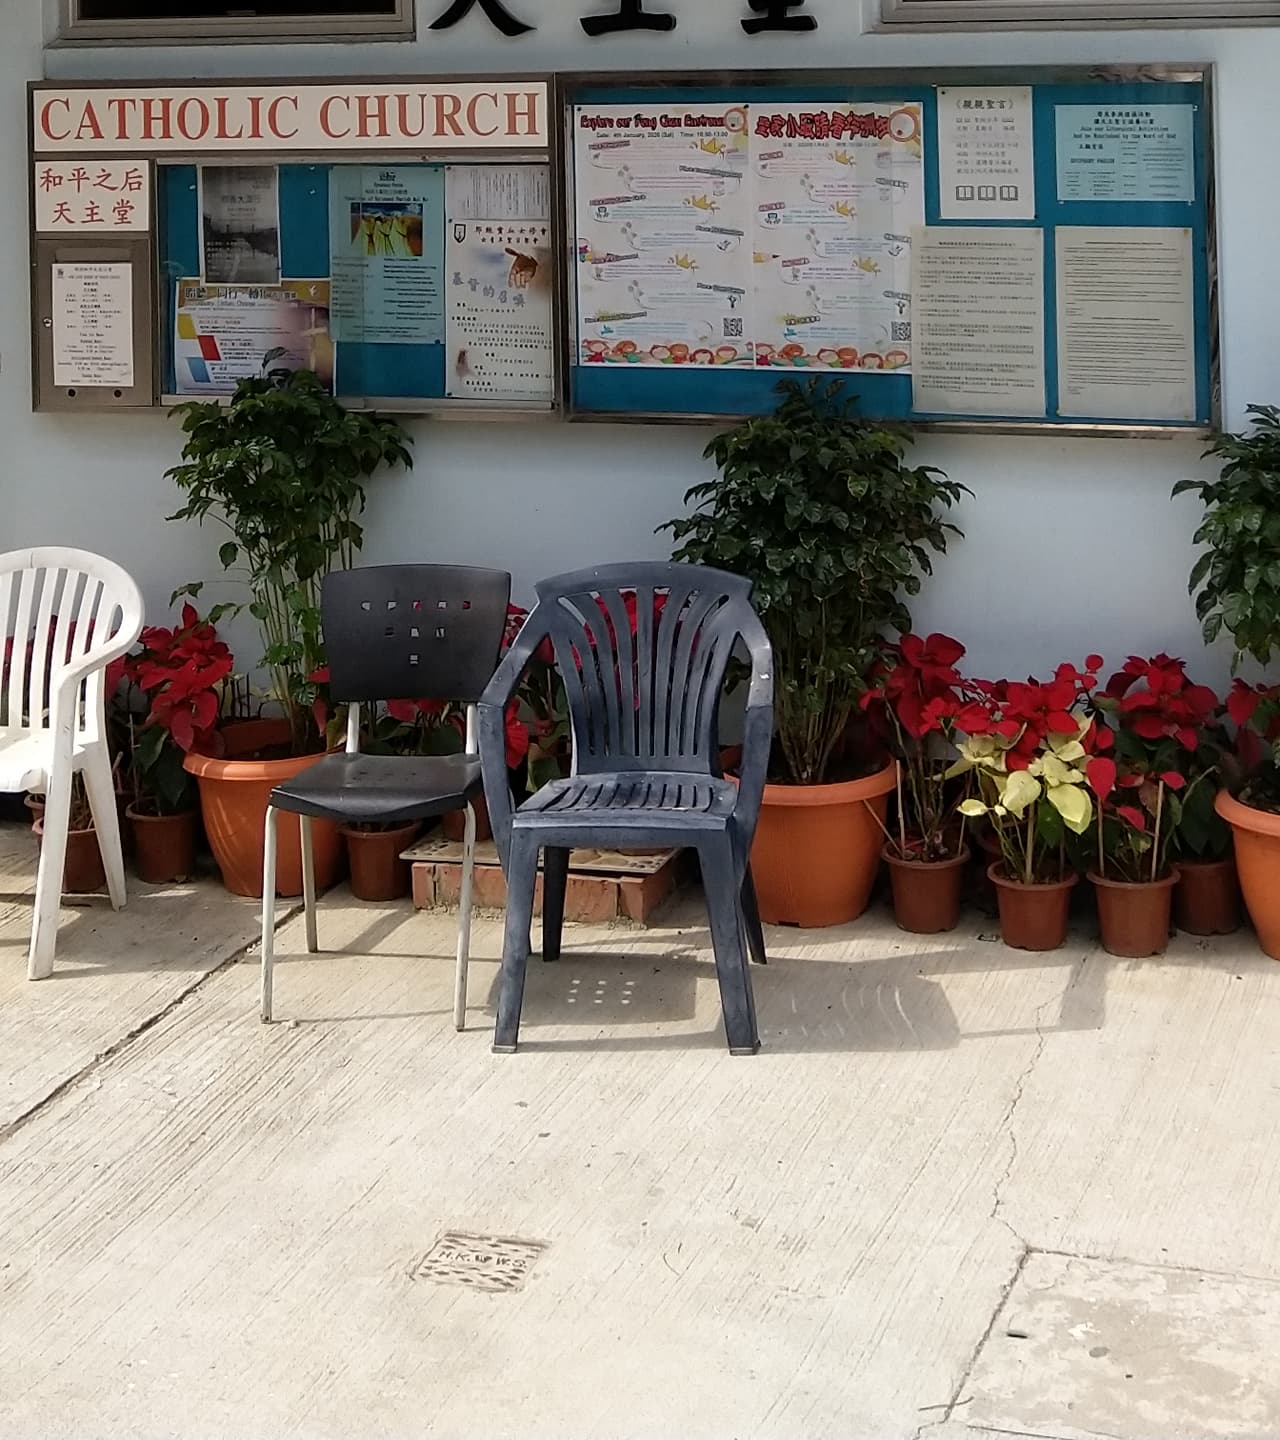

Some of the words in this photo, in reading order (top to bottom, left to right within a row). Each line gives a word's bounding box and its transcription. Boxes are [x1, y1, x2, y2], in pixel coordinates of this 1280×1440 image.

[41, 97, 299, 140] CATHOLIC
[319, 93, 539, 137] CHURCH
[616, 117, 632, 128] our
[40, 167, 144, 194] 和平之后
[52, 200, 135, 226] 天主堂
